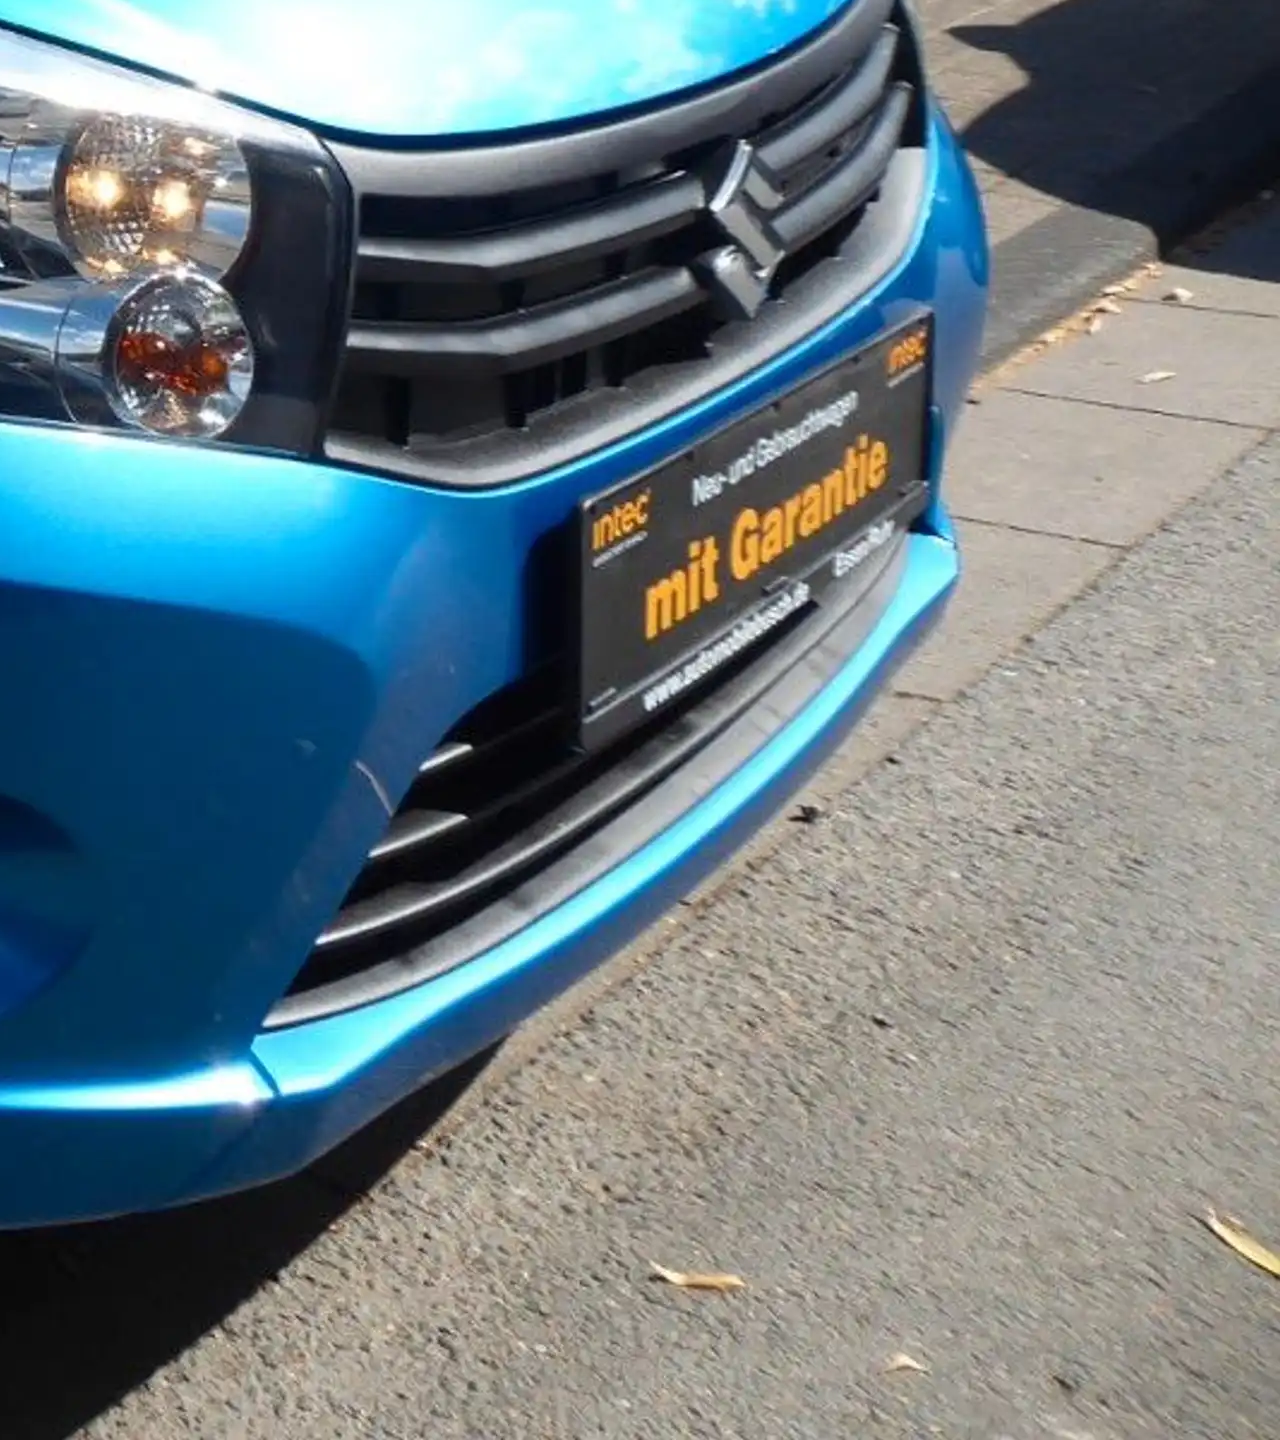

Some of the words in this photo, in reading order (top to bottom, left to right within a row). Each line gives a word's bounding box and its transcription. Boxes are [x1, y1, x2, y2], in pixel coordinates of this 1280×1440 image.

[592, 493, 649, 550] intec
[645, 534, 720, 641] mit
[730, 433, 890, 581] Garantie
